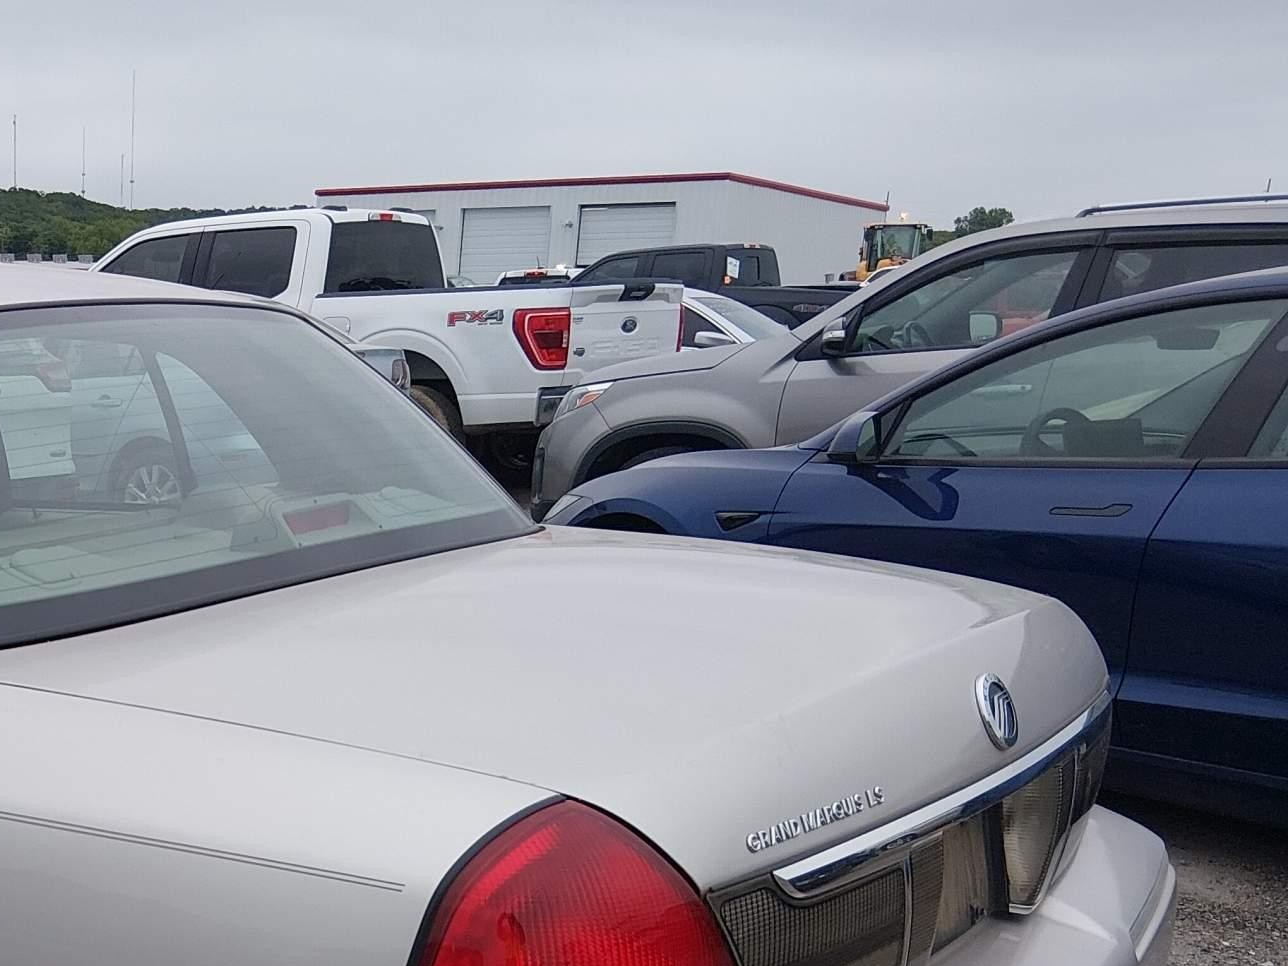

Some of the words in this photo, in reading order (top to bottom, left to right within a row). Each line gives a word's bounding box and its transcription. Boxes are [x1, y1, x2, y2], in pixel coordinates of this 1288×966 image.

[447, 309, 504, 327] FX4
[746, 819, 800, 853] GRAND
[800, 794, 863, 833] MARQUIS
[865, 786, 885, 808] LS
